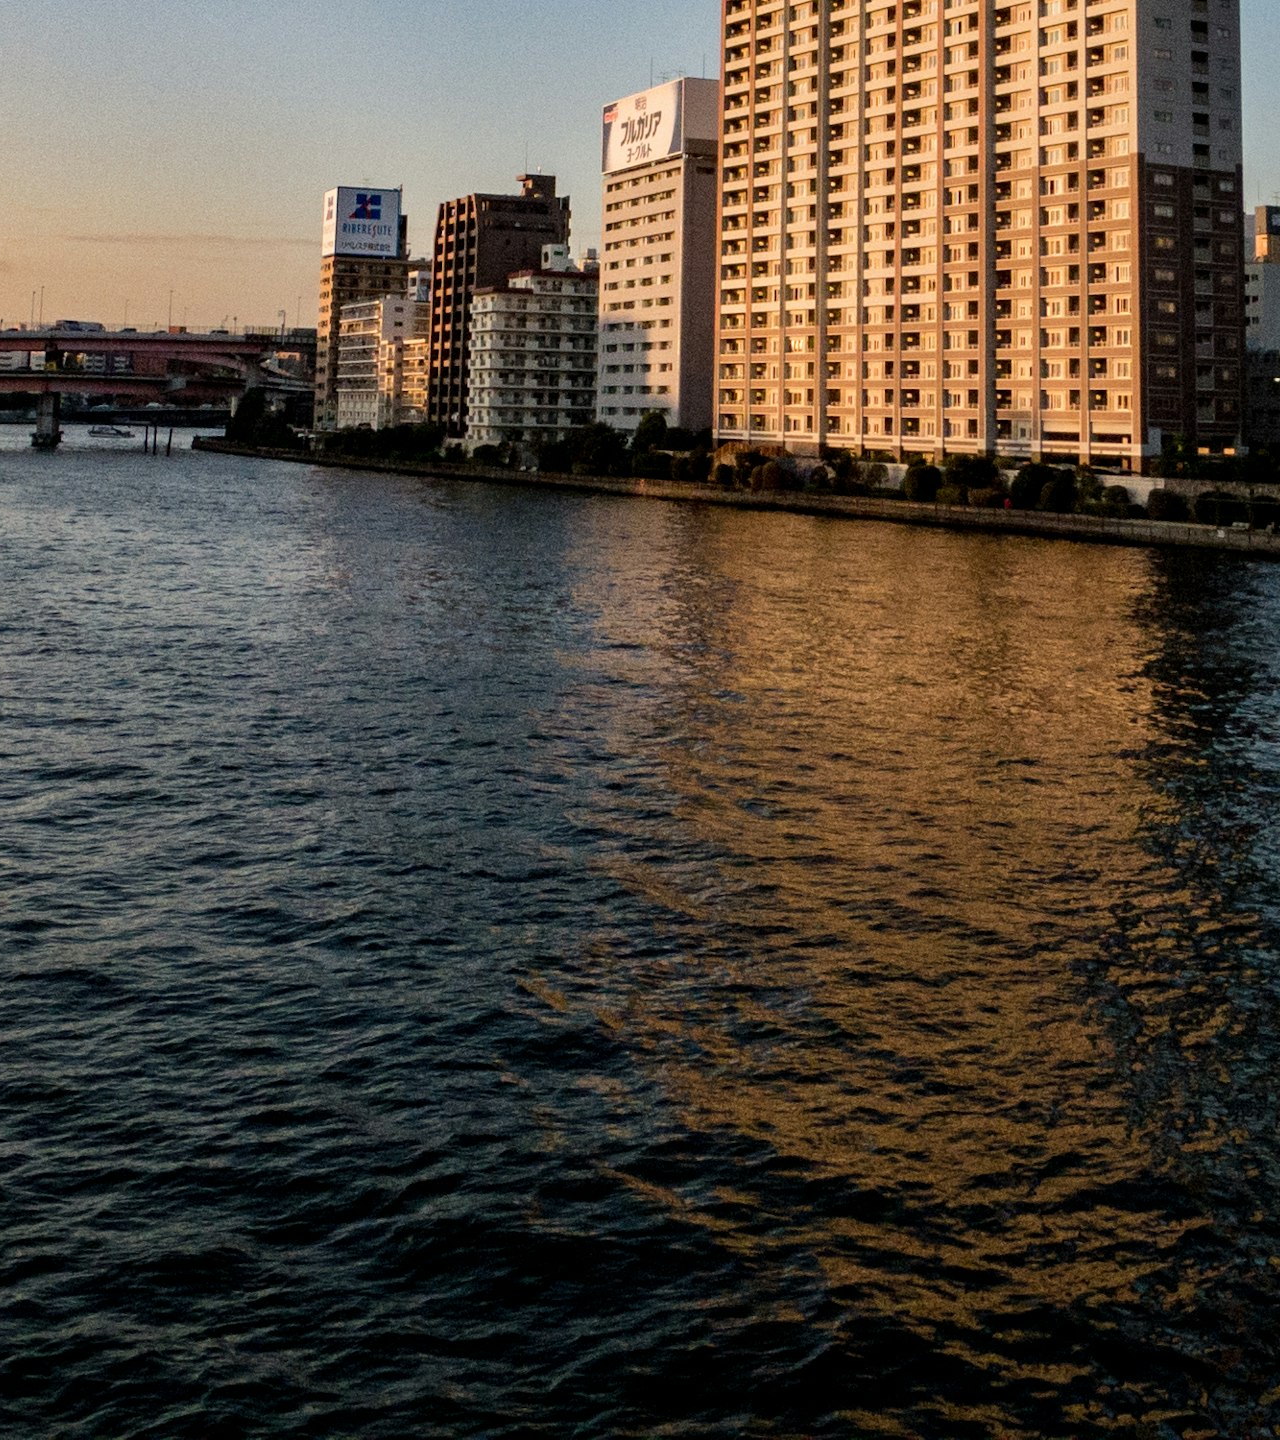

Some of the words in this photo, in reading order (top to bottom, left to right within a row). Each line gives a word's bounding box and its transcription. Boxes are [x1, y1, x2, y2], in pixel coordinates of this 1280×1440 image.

[620, 111, 662, 147] ブルガリア
[626, 142, 652, 163] ヨーグルト
[342, 222, 392, 238] RIBERESUTE
